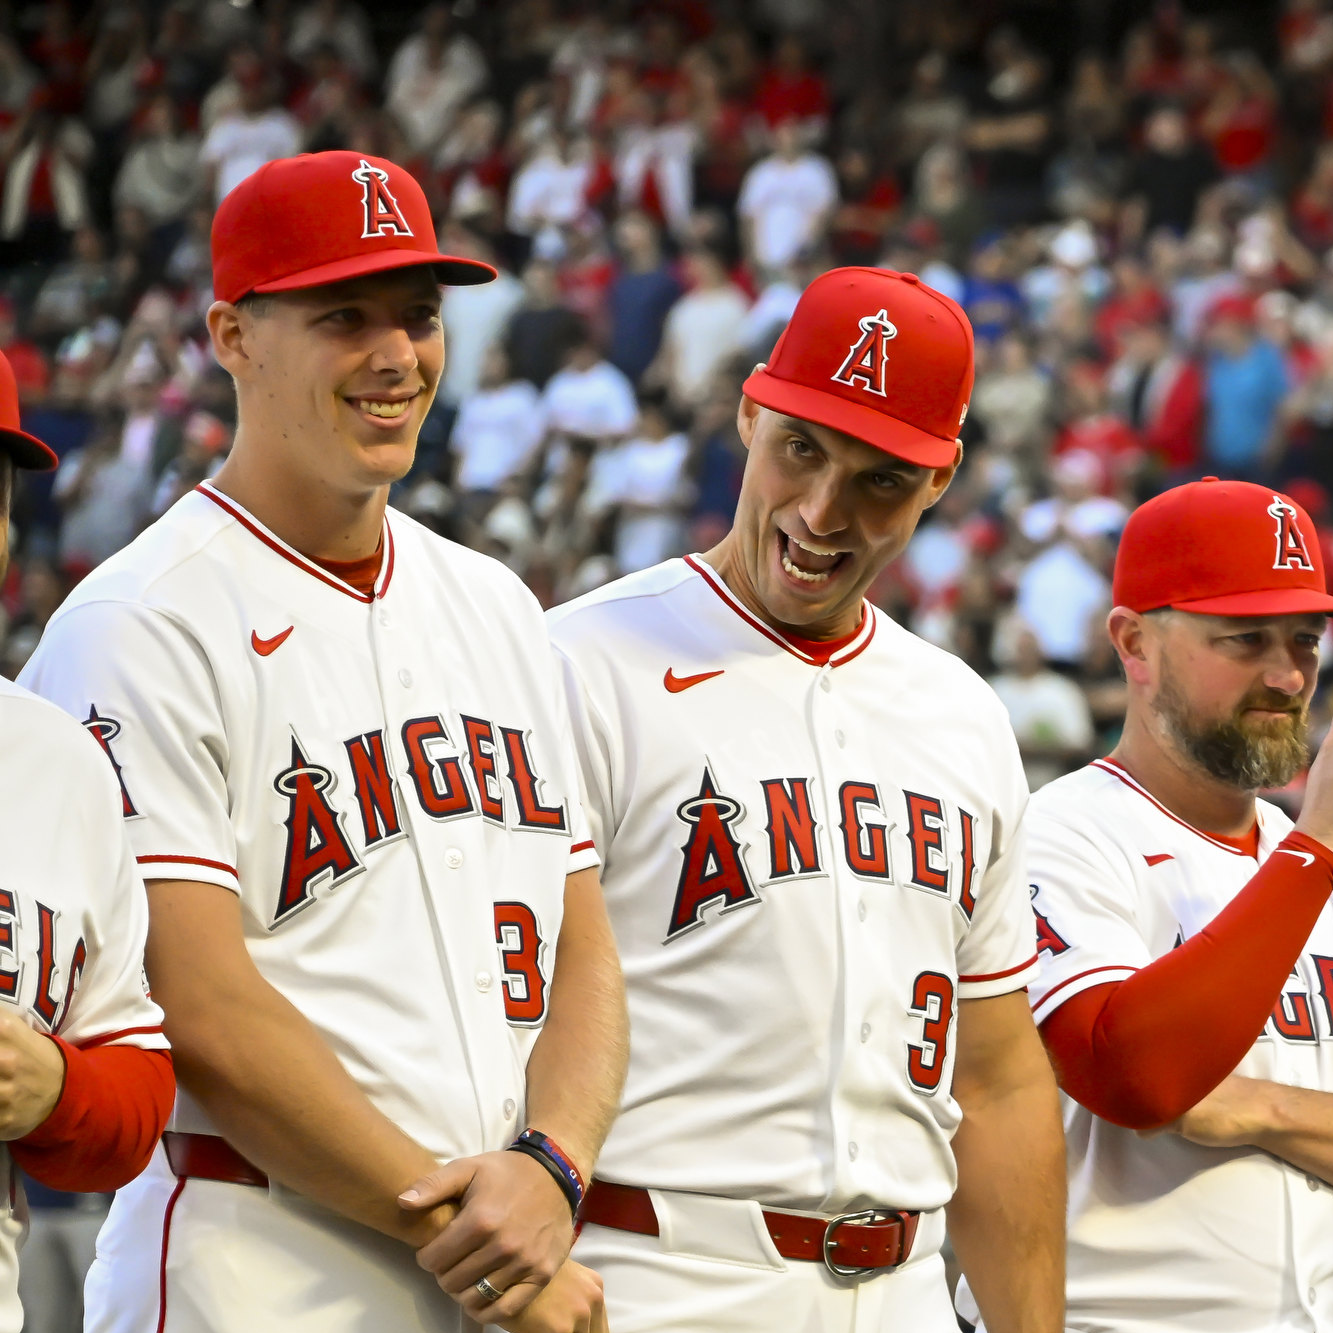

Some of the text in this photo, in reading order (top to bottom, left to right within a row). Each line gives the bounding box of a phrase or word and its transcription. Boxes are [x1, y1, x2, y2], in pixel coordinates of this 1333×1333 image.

[352, 160, 414, 239] A
[830, 308, 898, 398] A
[1267, 495, 1315, 572] A
